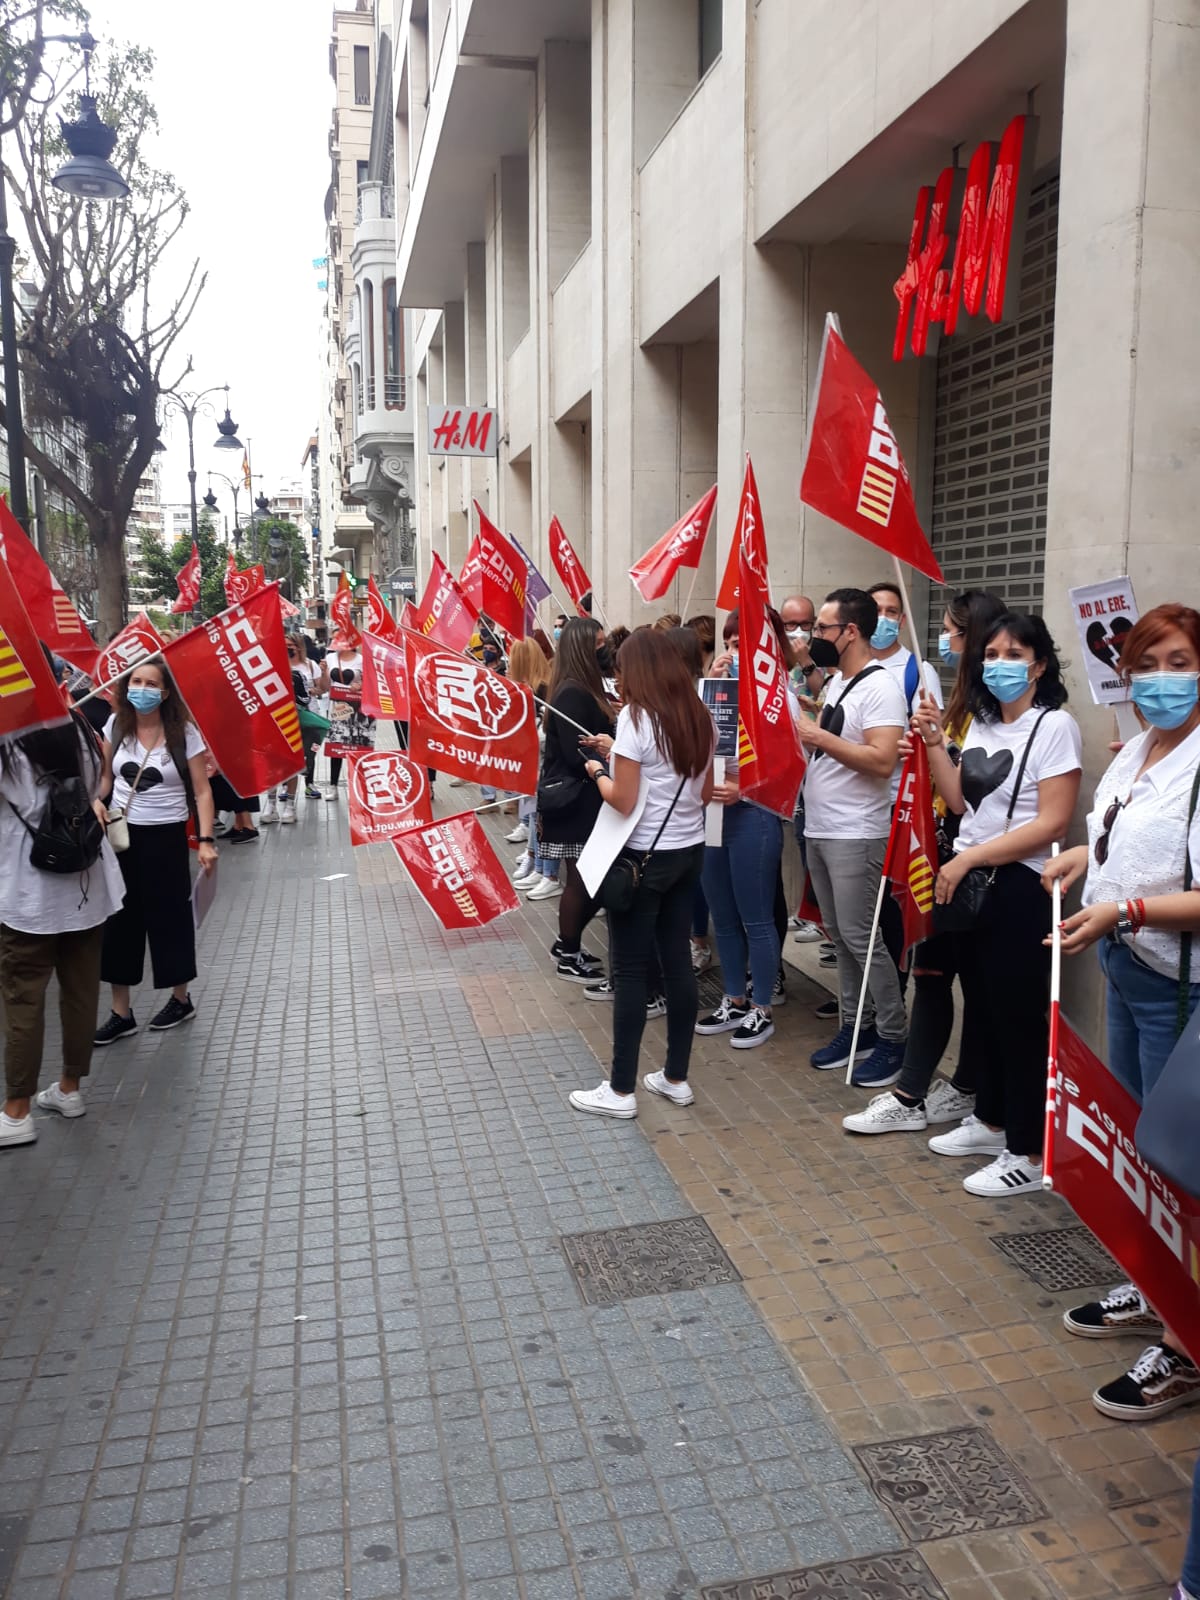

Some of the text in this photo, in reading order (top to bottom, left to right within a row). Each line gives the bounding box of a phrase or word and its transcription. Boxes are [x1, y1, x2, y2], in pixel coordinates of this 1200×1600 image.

[893, 114, 1026, 363] H&M
[433, 410, 492, 452] H&M
[480, 538, 514, 584] COO
[1079, 603, 1093, 619] NO
[1095, 600, 1107, 616] AL
[216, 645, 259, 717] valencià
